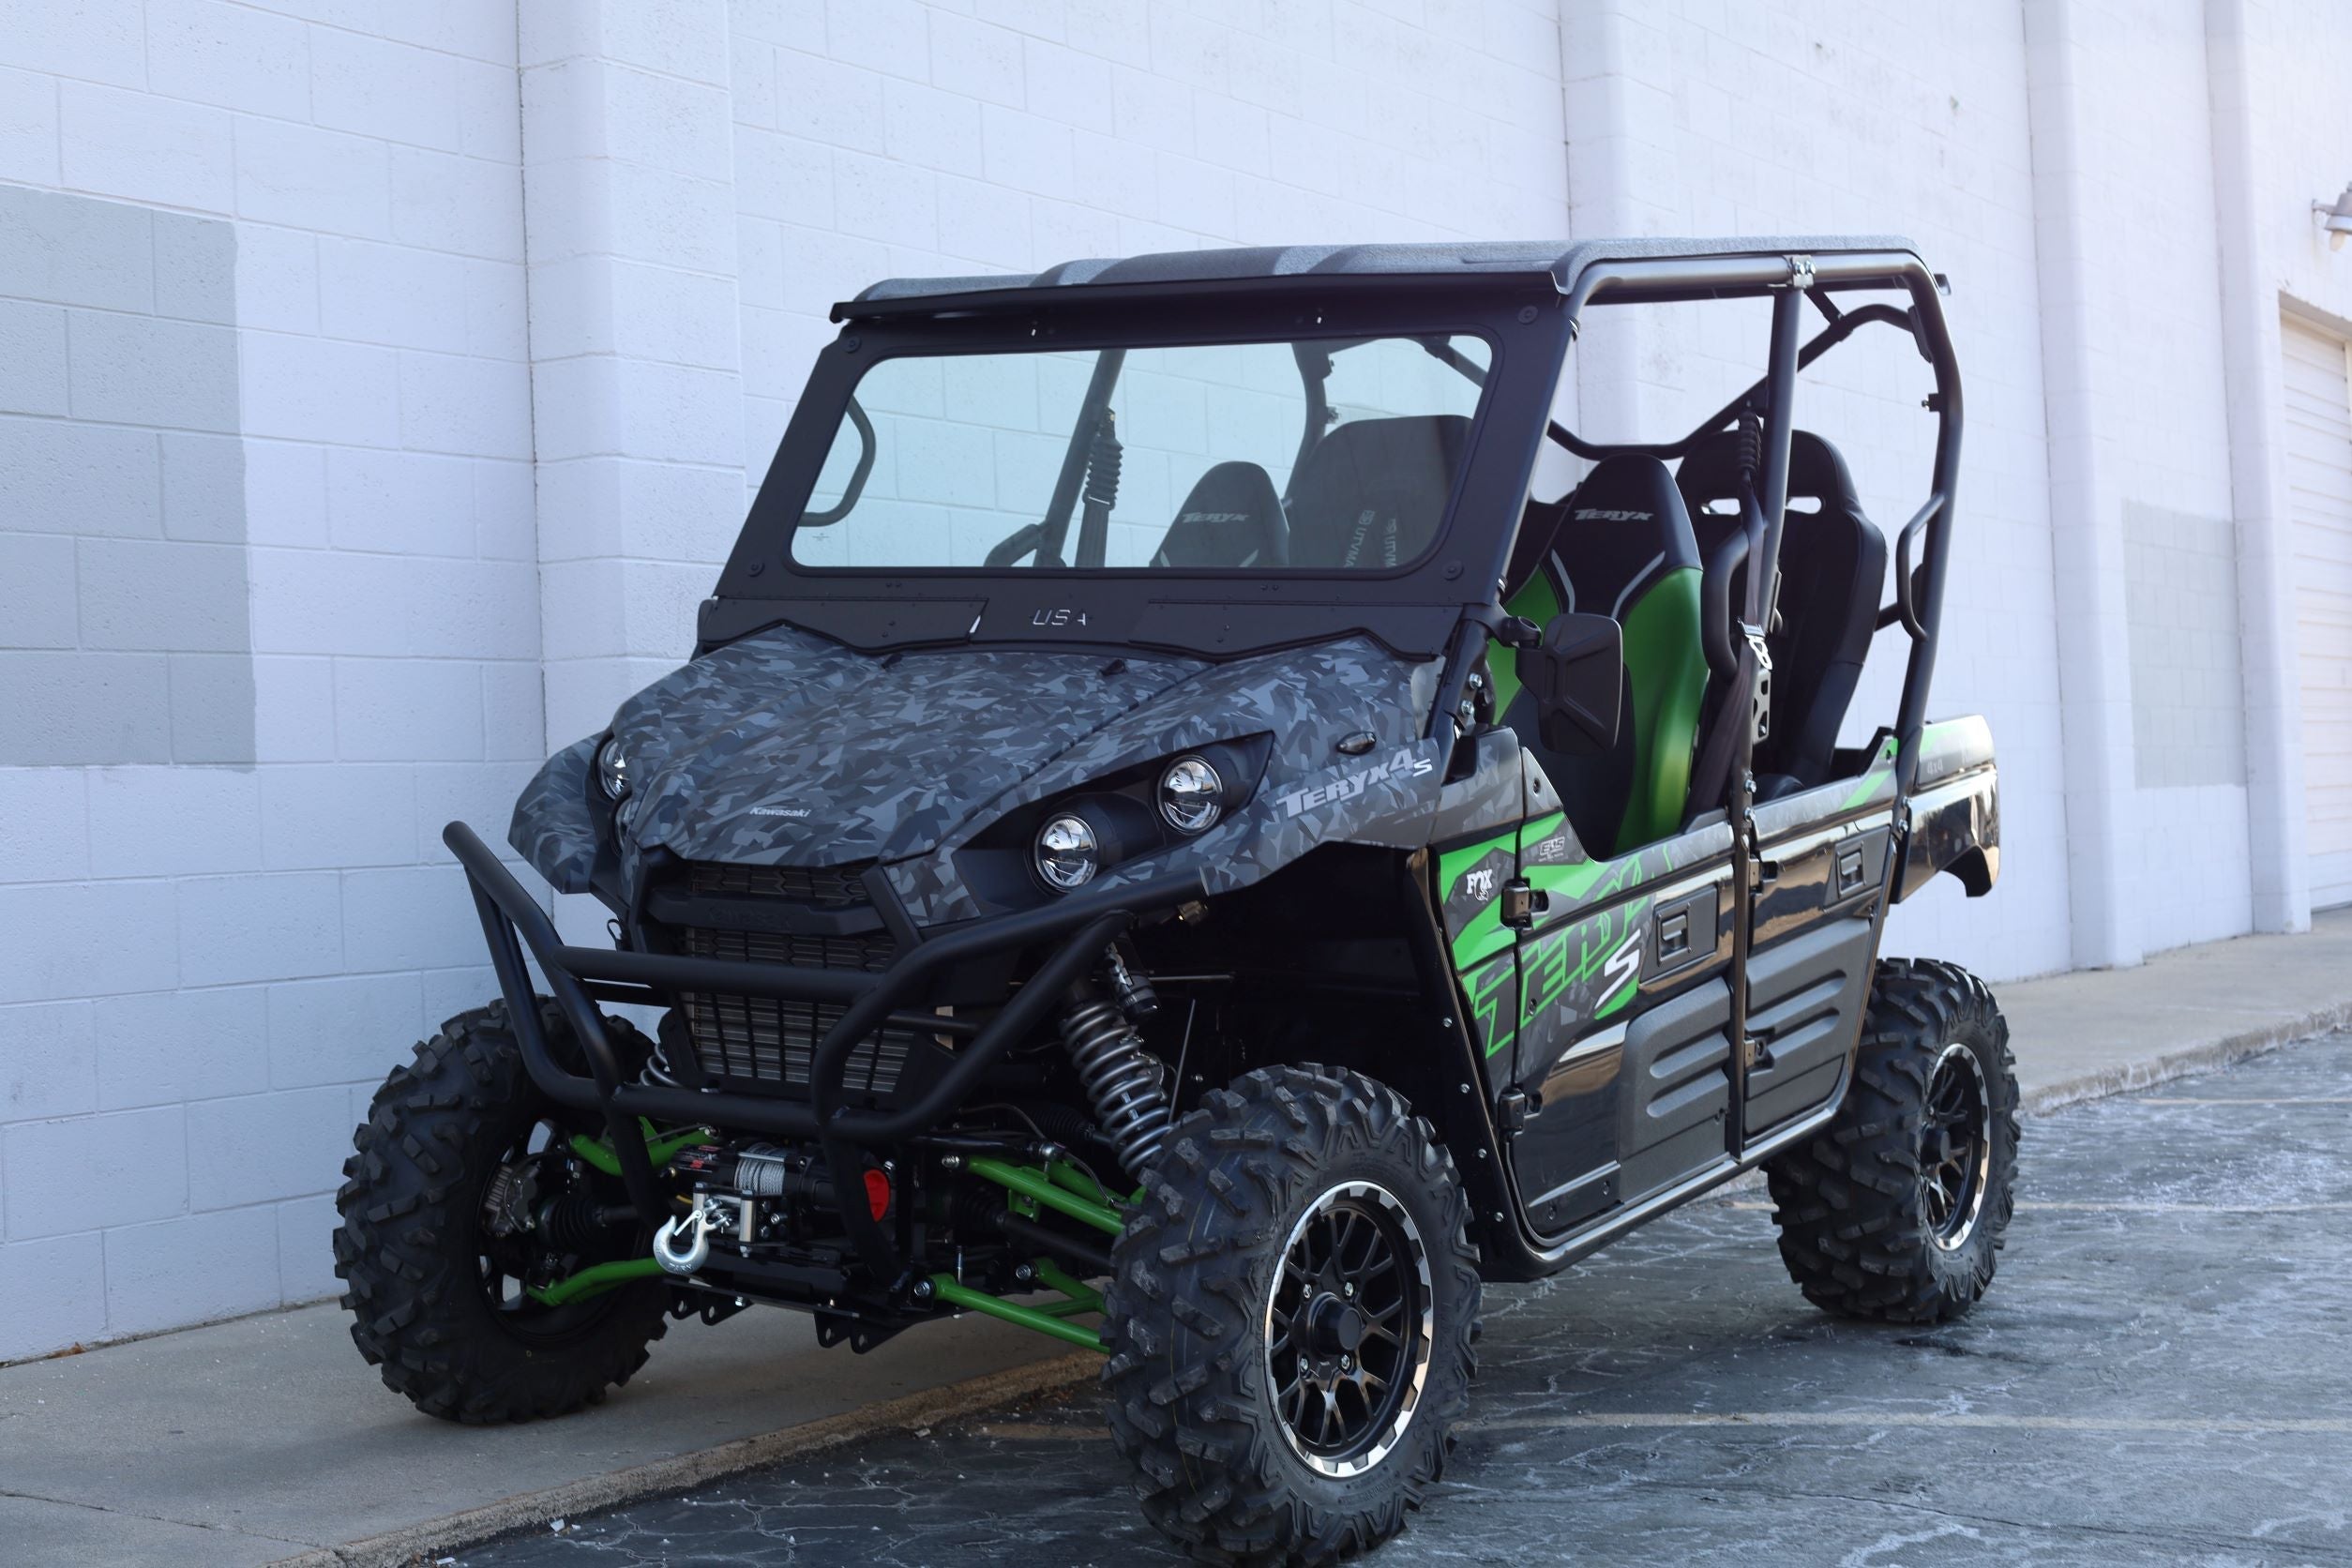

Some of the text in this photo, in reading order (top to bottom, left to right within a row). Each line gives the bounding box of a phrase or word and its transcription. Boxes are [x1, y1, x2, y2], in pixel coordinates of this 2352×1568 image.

[1575, 508, 1654, 521] TERYX
[1033, 609, 1087, 626] USA
[749, 807, 812, 818] Kawasaki
[1466, 868, 1493, 901] FOX
